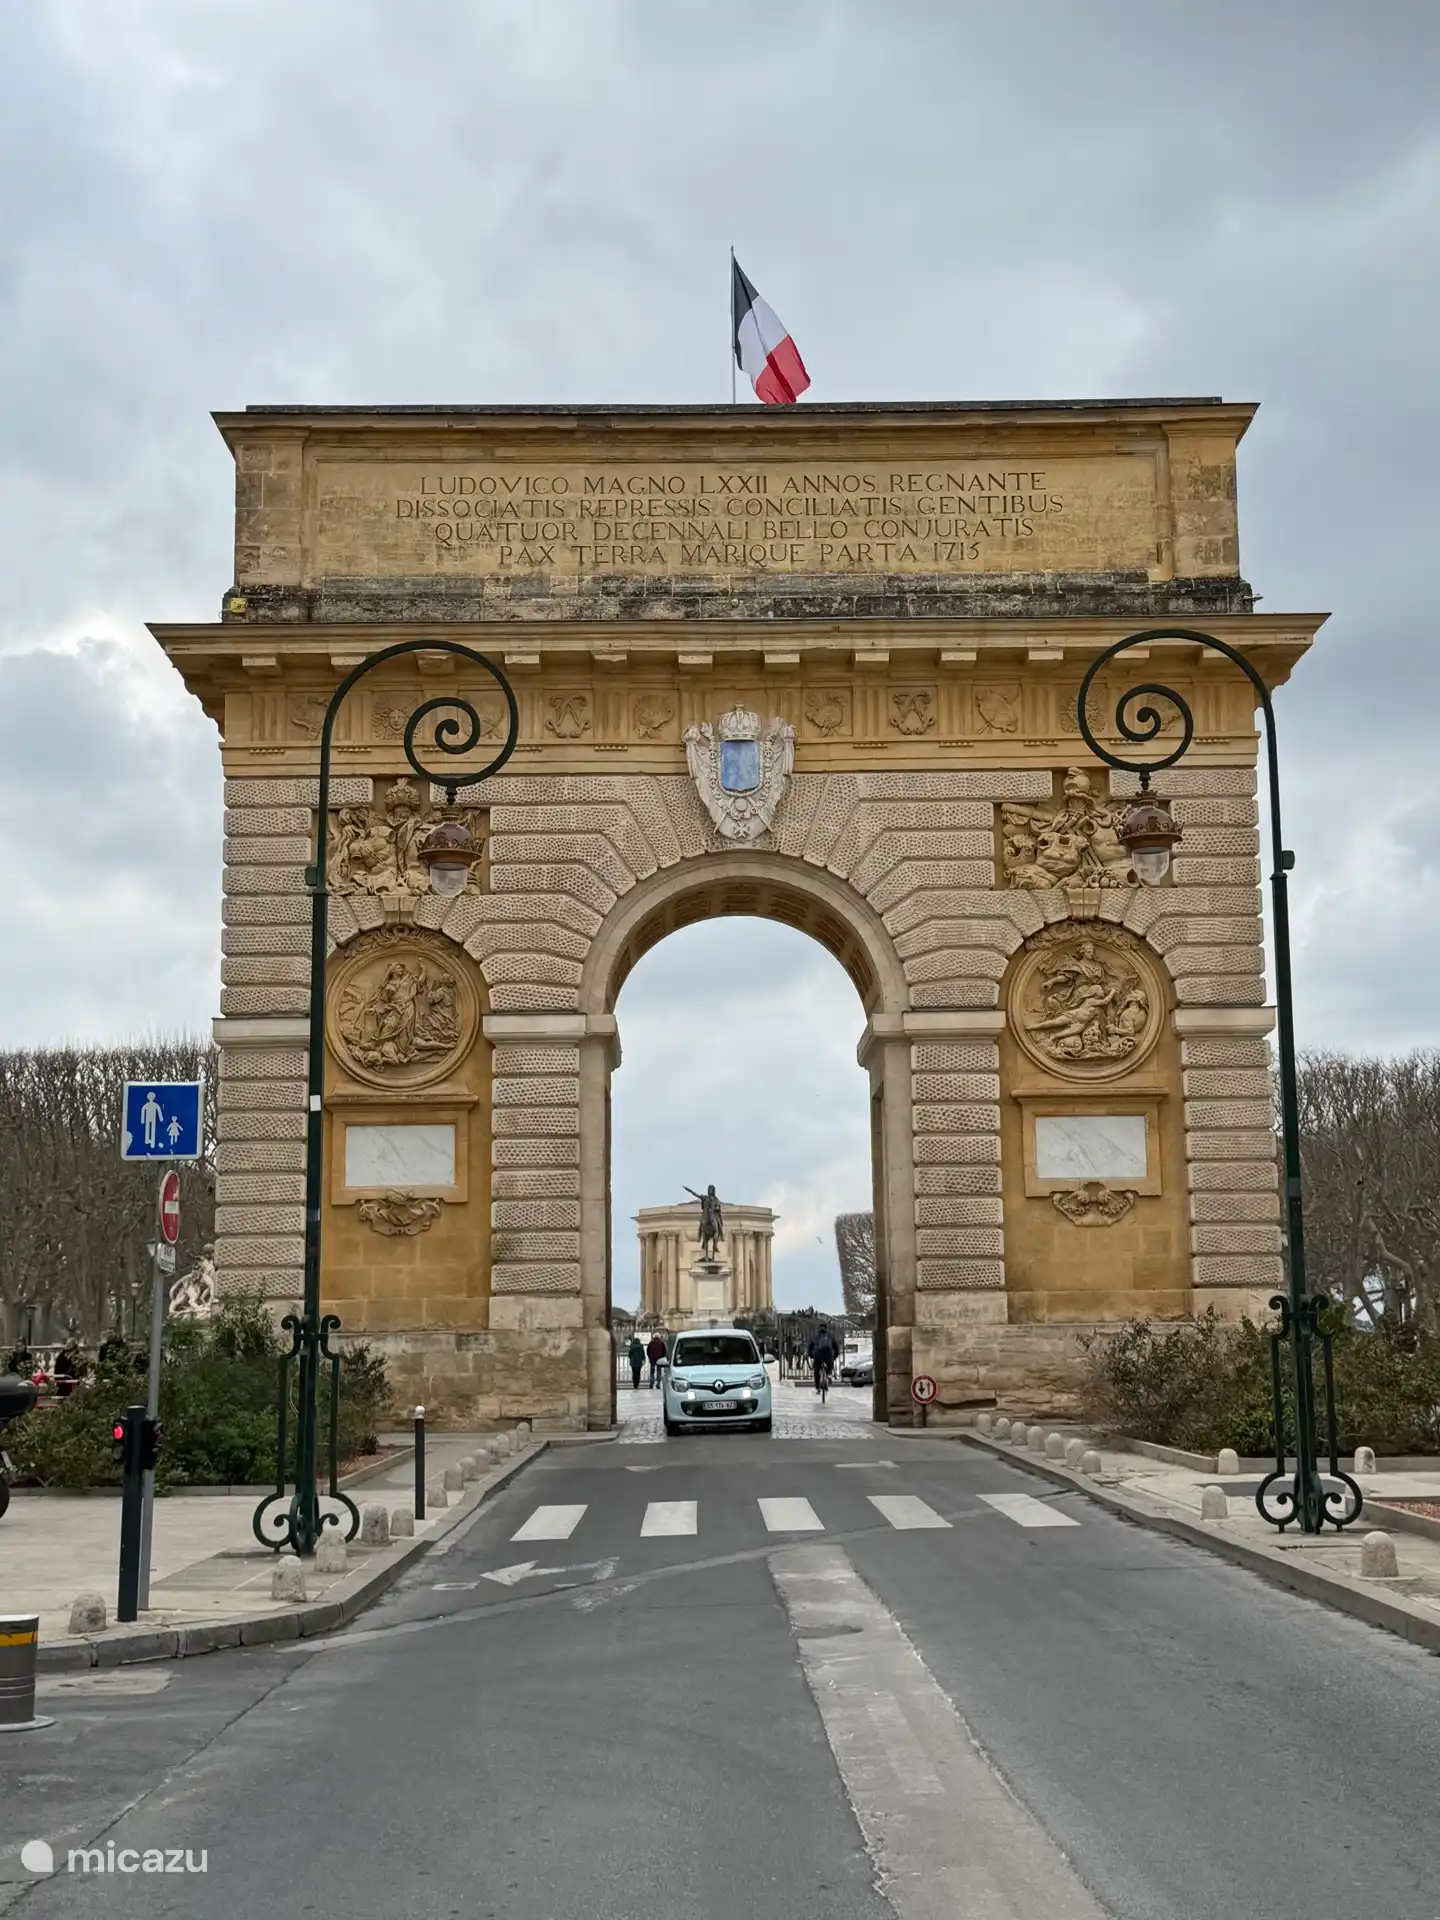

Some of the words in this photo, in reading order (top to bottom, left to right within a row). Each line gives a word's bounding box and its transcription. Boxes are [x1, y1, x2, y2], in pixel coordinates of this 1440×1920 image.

[420, 476, 569, 495] LUDOVICO
[583, 475, 686, 495] MAGNO
[700, 475, 768, 494] LXXII
[782, 474, 877, 493] ANNOS
[889, 472, 1047, 493] REGNANTE
[395, 499, 566, 519] DISSOCIATIS
[579, 498, 711, 518] REPRESSIS
[726, 497, 902, 517] CONCILIATIS
[917, 494, 1065, 514] GENTIBUS
[434, 521, 578, 547] QUATUOR
[593, 521, 750, 542] DECENNALI
[763, 520, 849, 541] BELLO
[863, 517, 1035, 540] CONJURATIS
[500, 544, 556, 565] PAX
[571, 544, 667, 564] TERRA
[680, 543, 806, 568] MARIQUE
[820, 542, 919, 562] PARTA
[932, 541, 981, 562] 1715
